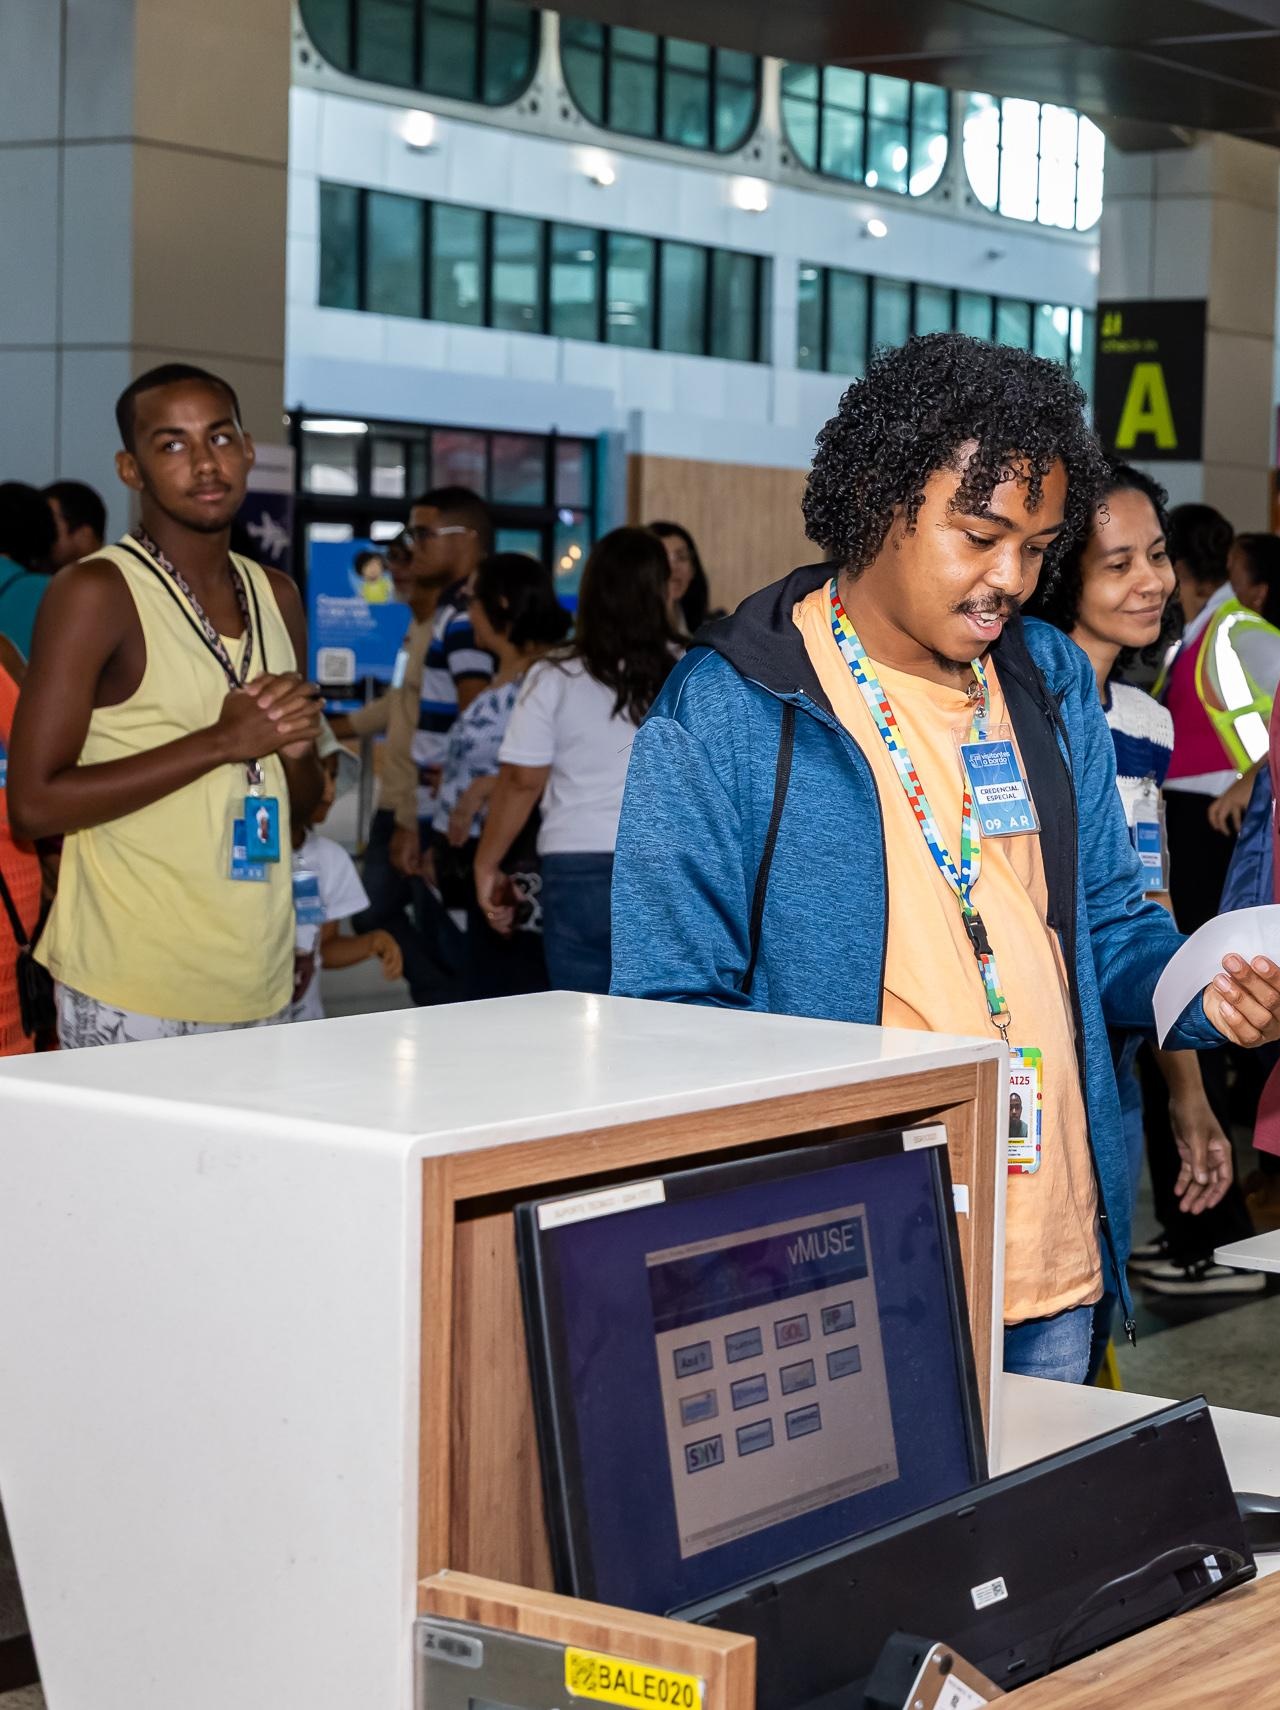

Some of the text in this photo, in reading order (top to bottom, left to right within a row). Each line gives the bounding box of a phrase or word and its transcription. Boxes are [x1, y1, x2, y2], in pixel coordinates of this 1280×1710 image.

[1115, 362, 1178, 449] A
[981, 751, 1010, 760] visitantes
[980, 785, 1019, 795] CREDENCIAL
[986, 794, 1016, 802] ESPECIAL
[985, 818, 1001, 830] 09
[787, 1224, 855, 1265] vMUSE
[599, 1664, 694, 1708] BALE020
